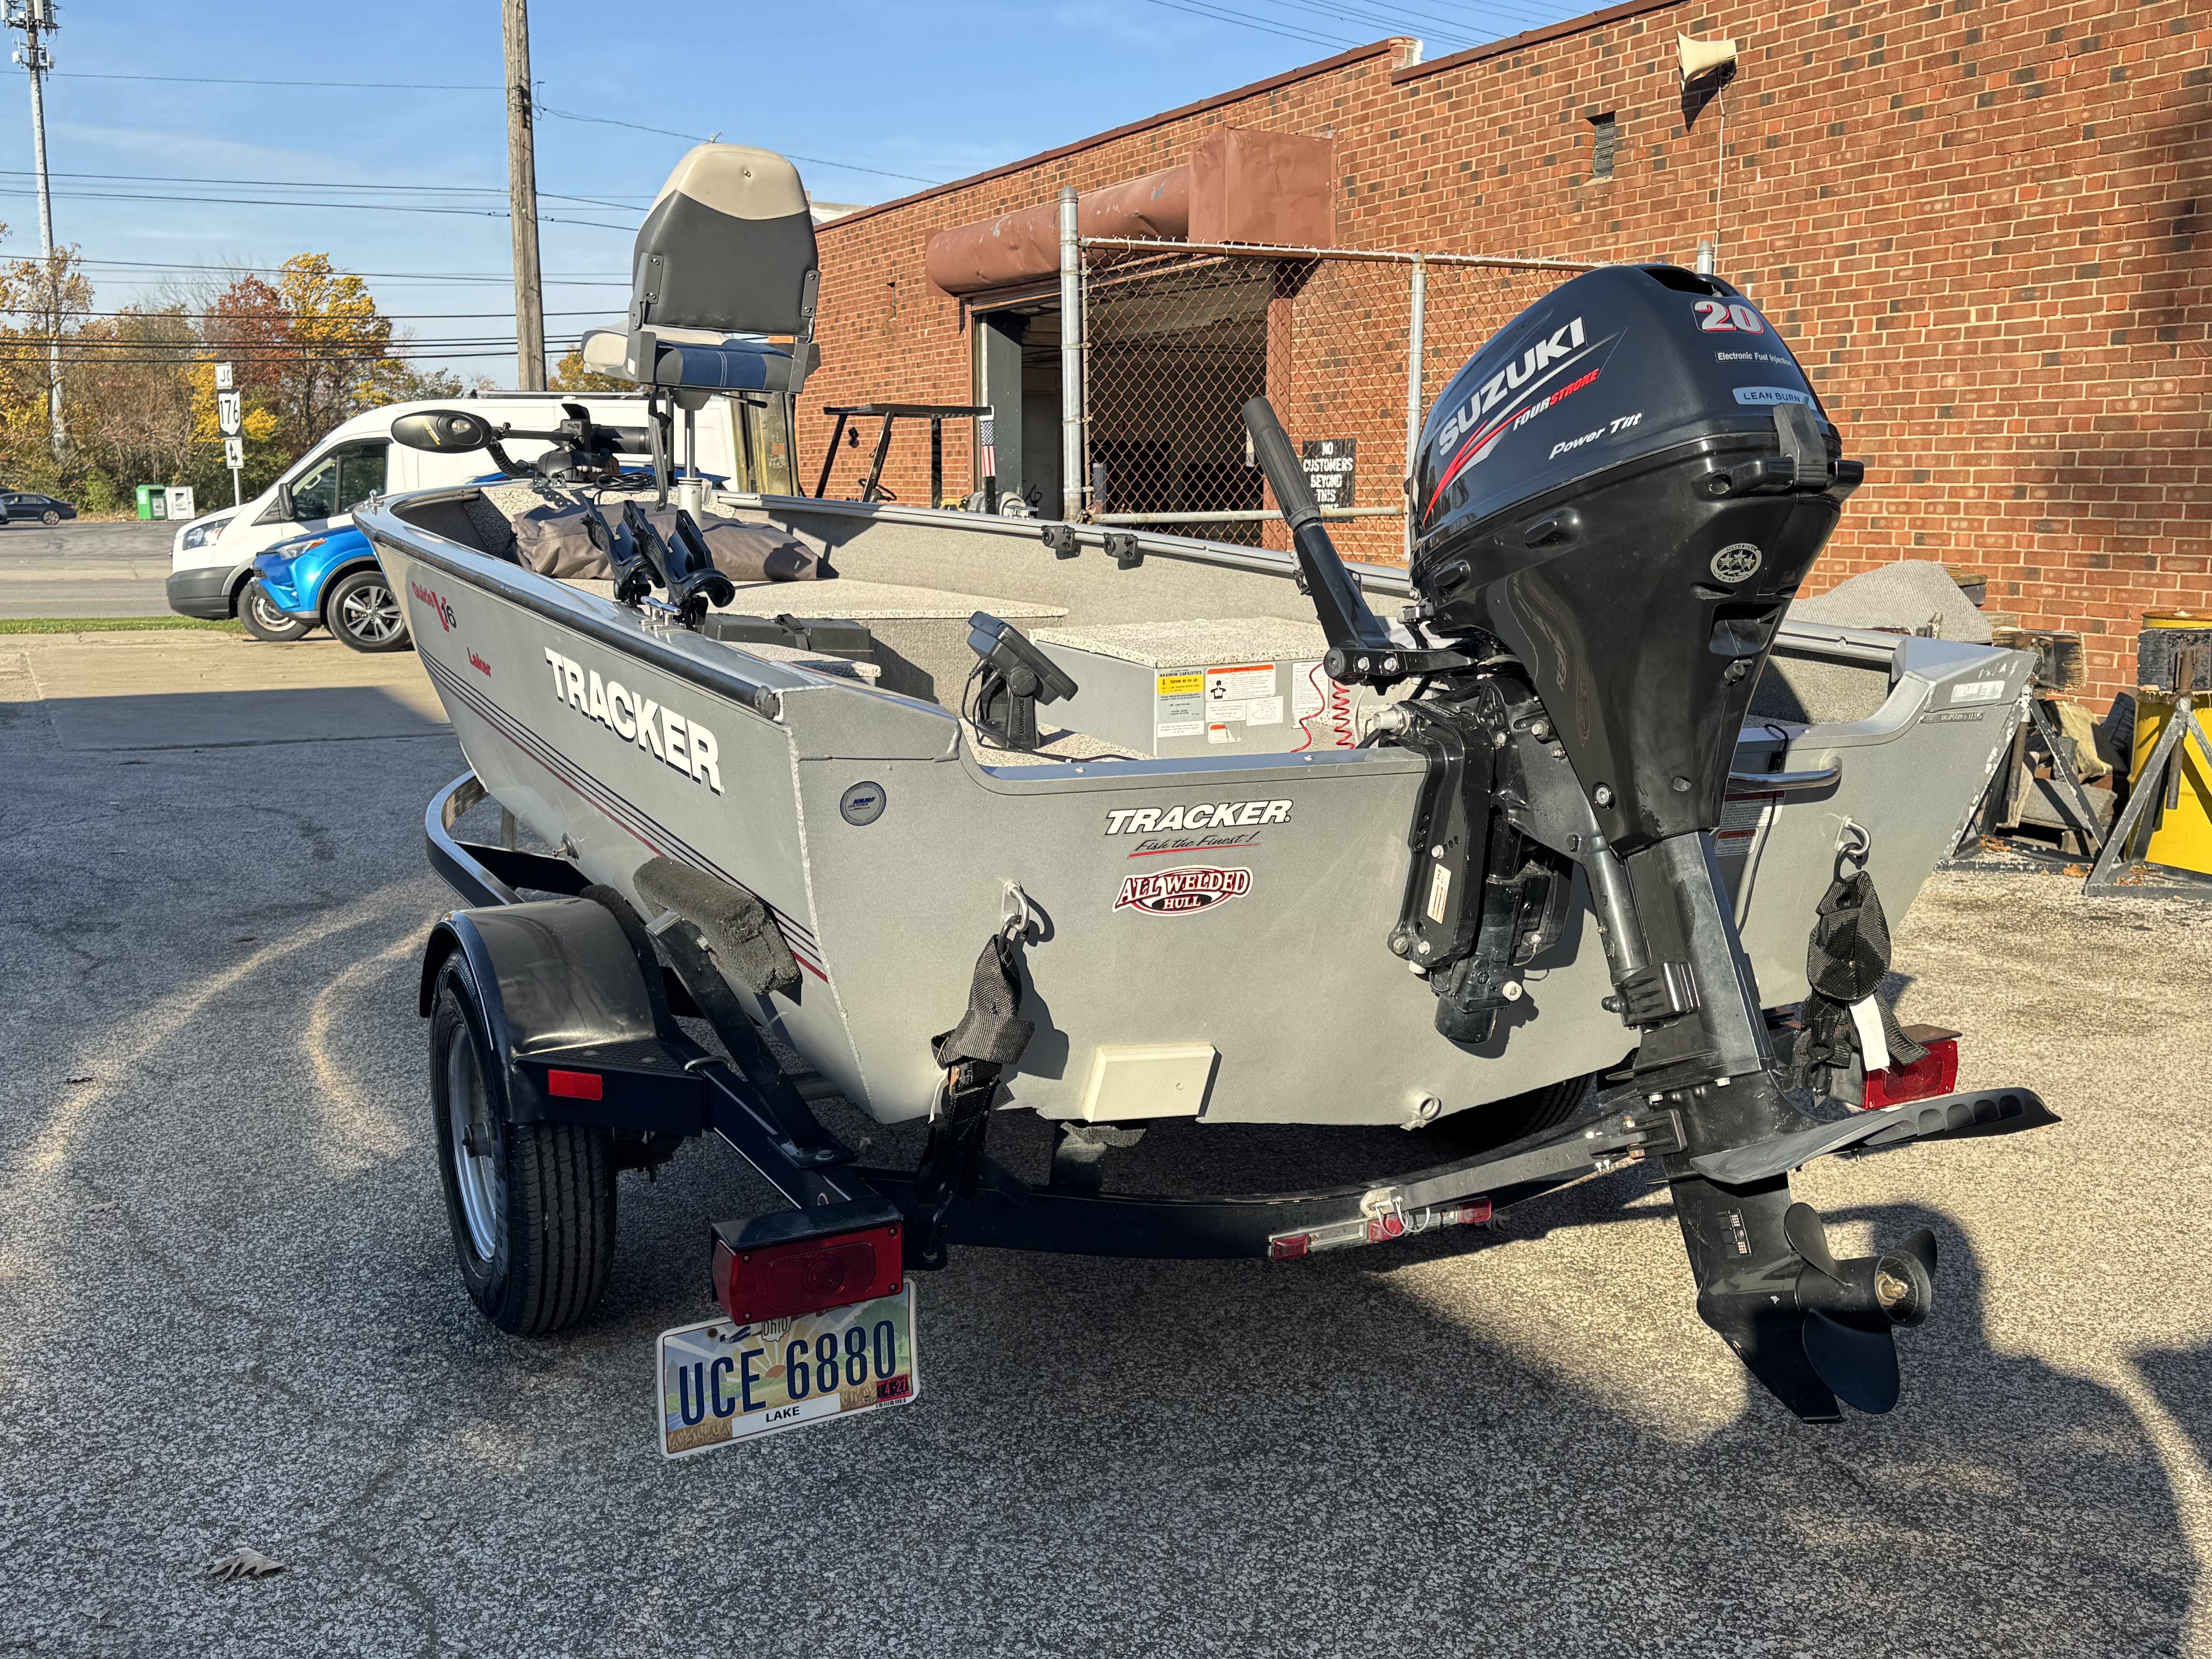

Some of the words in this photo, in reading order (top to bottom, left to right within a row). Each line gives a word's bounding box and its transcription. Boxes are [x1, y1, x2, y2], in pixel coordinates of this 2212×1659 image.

[1695, 301, 1764, 335] 20
[1717, 352, 1753, 361] Electronic
[1754, 352, 1768, 361] Fuel
[1769, 354, 1793, 367] Injection
[1439, 317, 1585, 456] SUZUKI
[1775, 393, 1801, 403] BURN
[220, 399, 239, 424] 176
[1513, 368, 1600, 431] FOURSTROKE
[1549, 428, 1606, 460] Power
[1610, 412, 1643, 434] Tilt
[1322, 442, 1334, 456] NO
[1303, 457, 1353, 472] CUSTOMERS
[1310, 474, 1342, 488] BEYOND
[1316, 489, 1336, 502] THIS
[412, 581, 435, 608] Guide
[467, 647, 491, 678] Laker
[544, 647, 721, 797] TRACKER
[1104, 799, 1293, 836] TRACKER
[1135, 838, 1169, 851] Fish
[1171, 838, 1194, 849] the
[1116, 875, 1162, 905] ALL
[1163, 870, 1250, 894] WELDED
[1163, 895, 1201, 910] HULL
[763, 1319, 788, 1336] Ohio
[679, 1348, 766, 1426] UCE
[786, 1320, 896, 1400] 6880
[766, 1406, 800, 1423] LAKE
